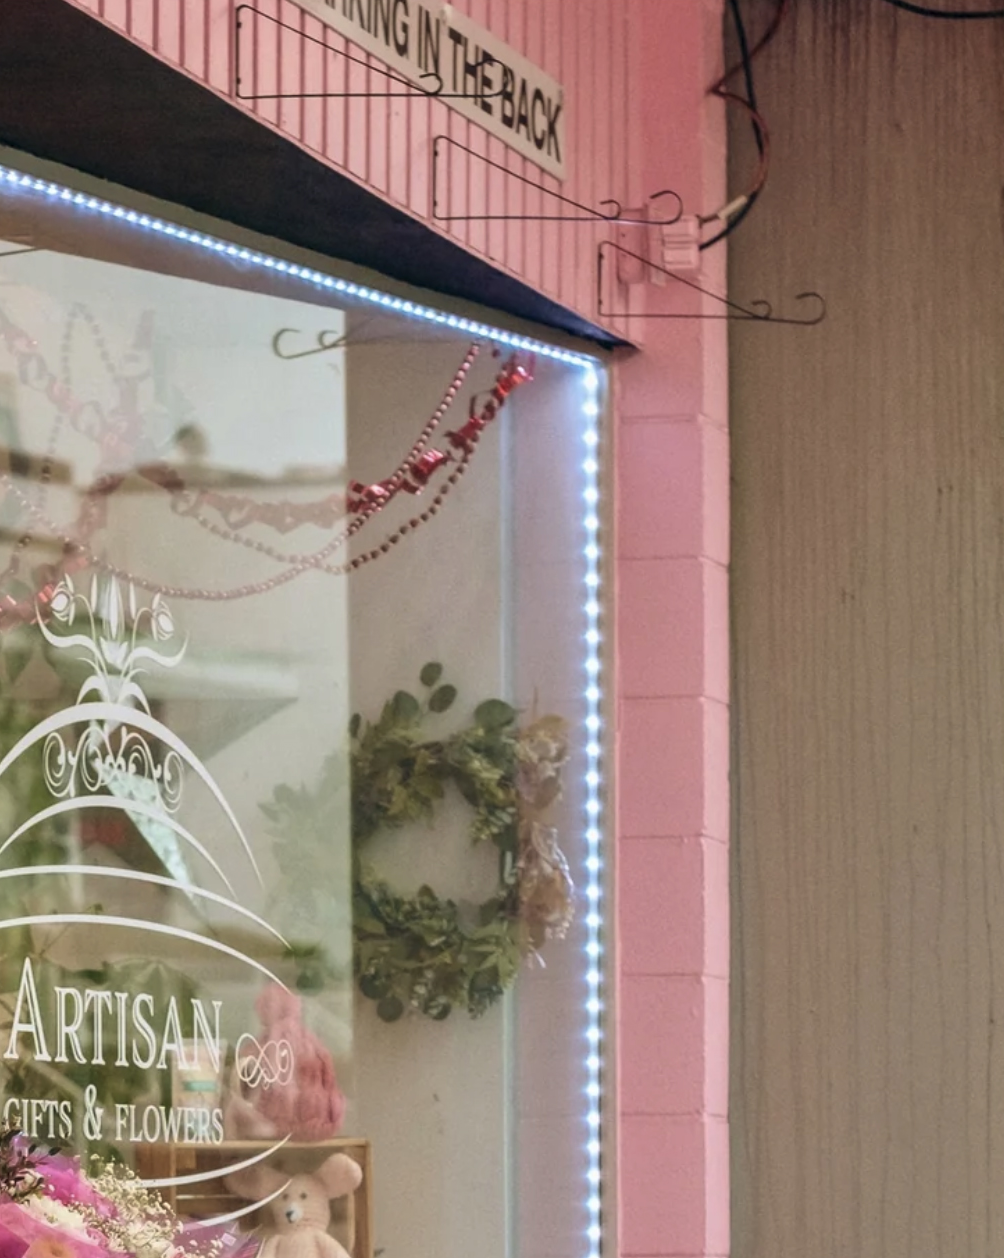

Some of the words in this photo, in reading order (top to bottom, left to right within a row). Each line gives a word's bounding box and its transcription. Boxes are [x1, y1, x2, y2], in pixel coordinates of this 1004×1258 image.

[417, 4, 440, 76] IN
[448, 27, 494, 117] THE
[500, 65, 562, 164] BACK
[3, 956, 223, 1073] ARTISAN
[3, 1097, 73, 1140] GIFTS
[83, 1084, 104, 1141] &
[115, 1103, 225, 1146] FLOWERS
